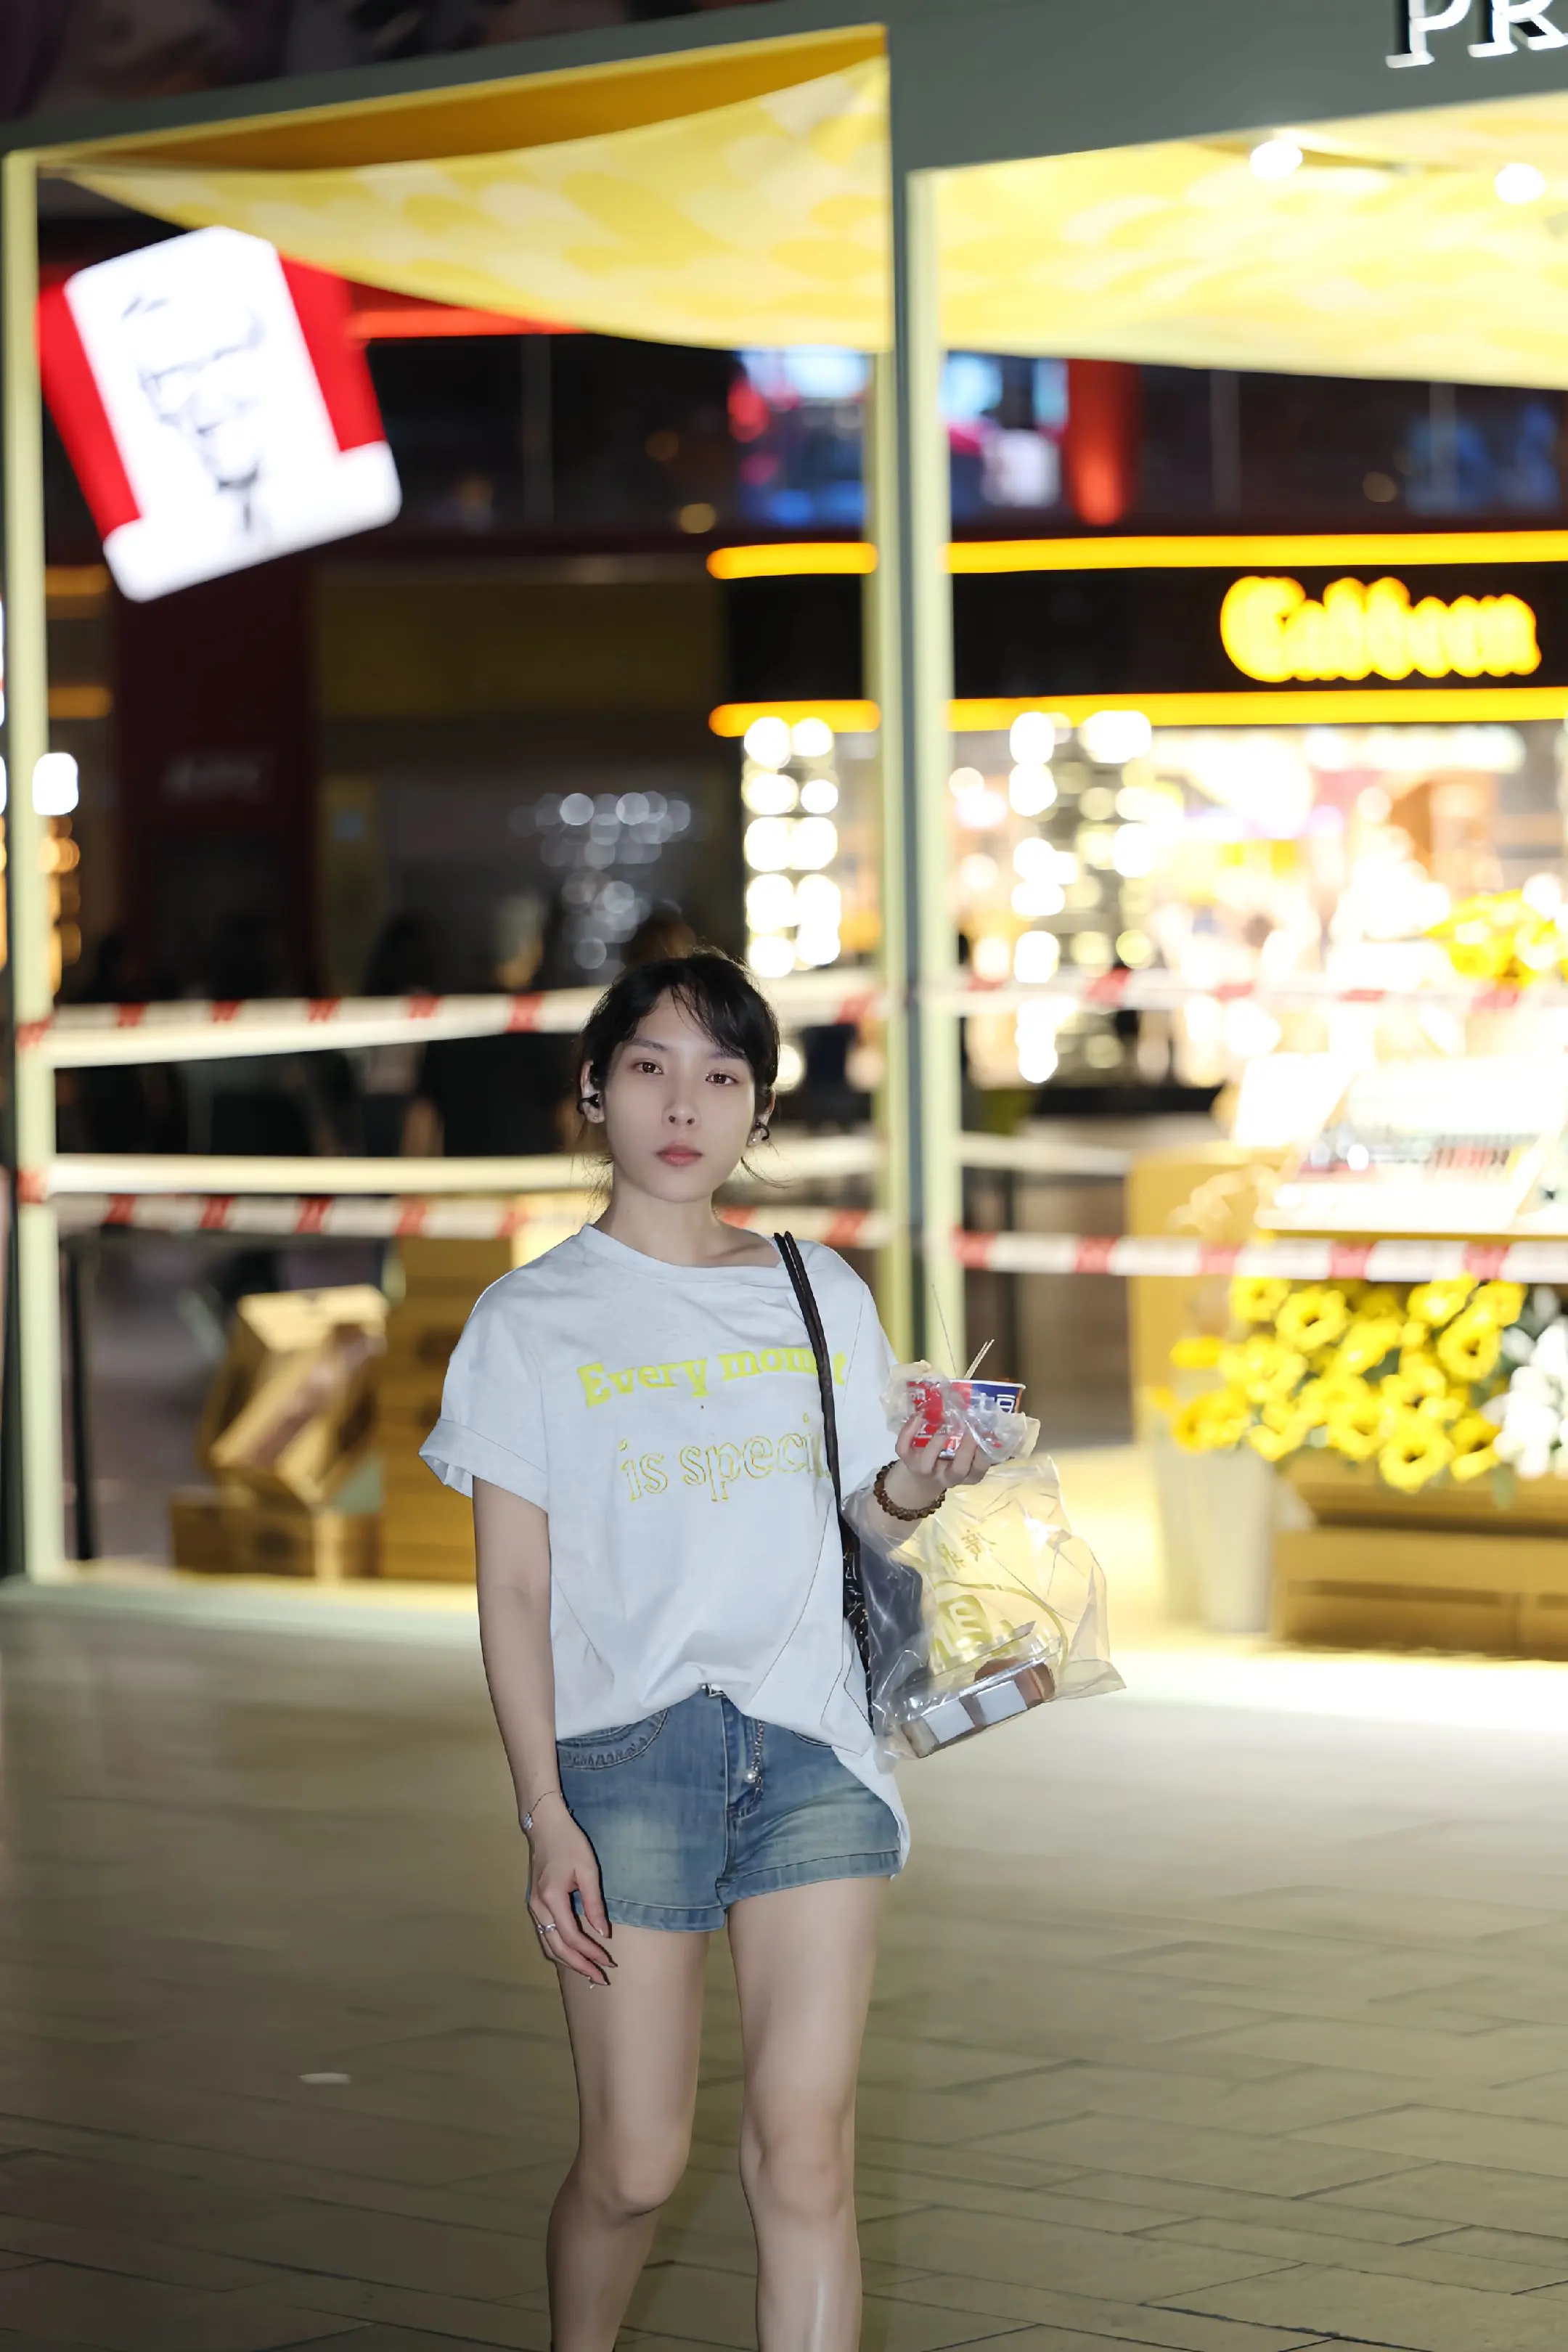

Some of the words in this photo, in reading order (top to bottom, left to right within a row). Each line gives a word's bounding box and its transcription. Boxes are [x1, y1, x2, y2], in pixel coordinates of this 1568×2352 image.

[577, 1357, 709, 1408] Every
[716, 1347, 847, 1386] momt
[618, 1438, 669, 1502] is
[679, 1412, 832, 1503] speci
